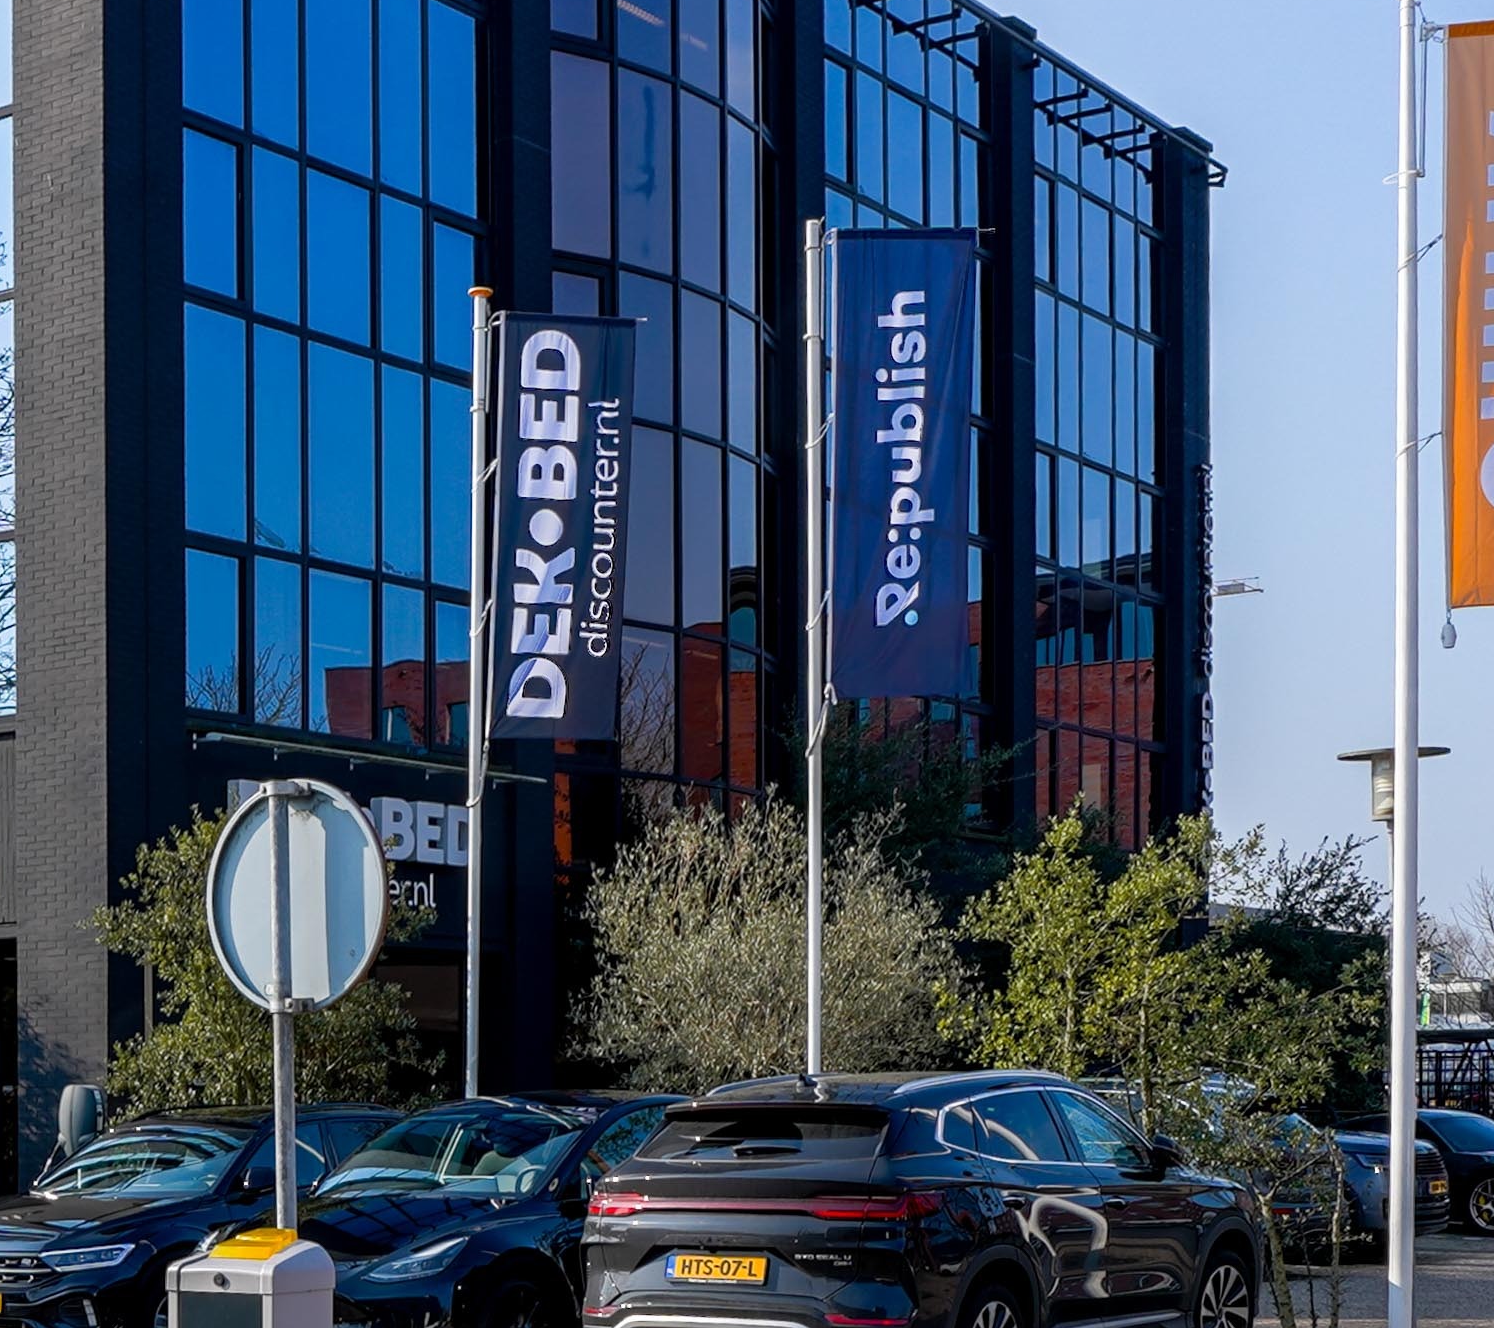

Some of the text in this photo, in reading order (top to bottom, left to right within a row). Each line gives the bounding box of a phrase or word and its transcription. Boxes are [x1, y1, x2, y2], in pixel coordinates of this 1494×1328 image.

[578, 397, 620, 658] discounter.nl
[875, 290, 935, 626] Re:publish
[681, 1259, 758, 1277] HTS-07-L
